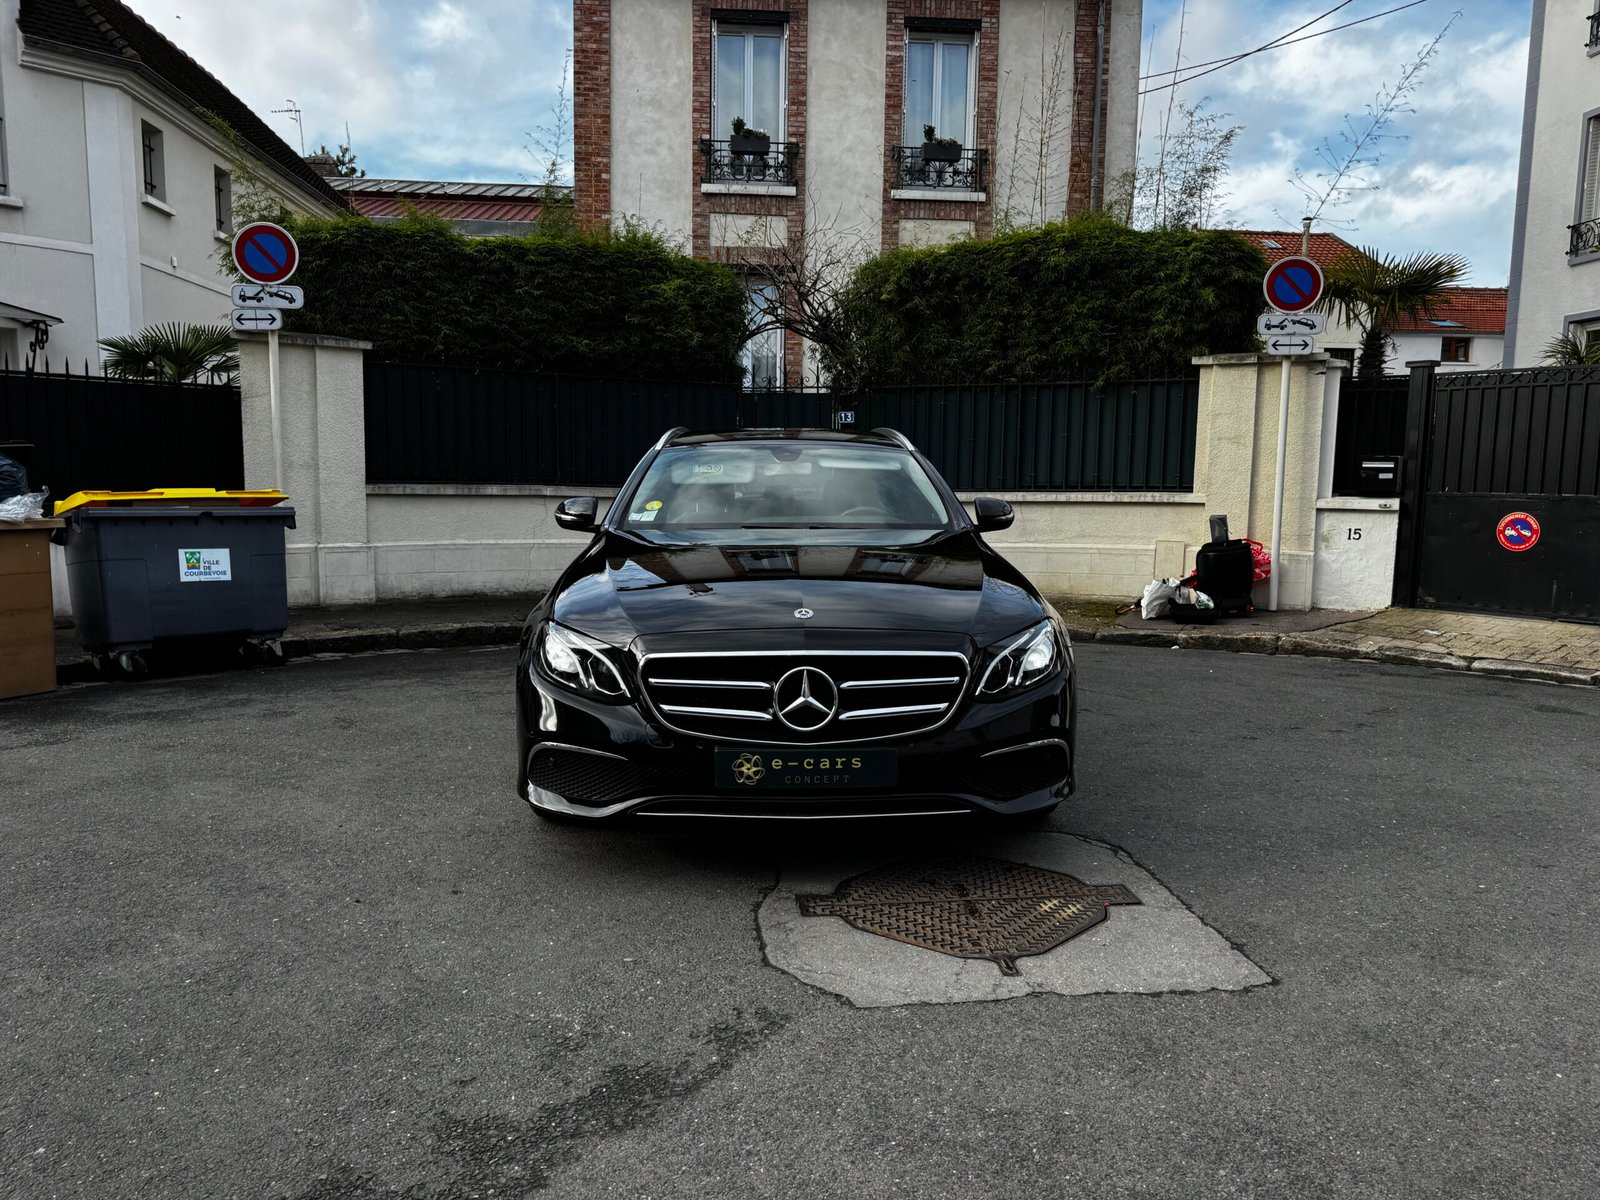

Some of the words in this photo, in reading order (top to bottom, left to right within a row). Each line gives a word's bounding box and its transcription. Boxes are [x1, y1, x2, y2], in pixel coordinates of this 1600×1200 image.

[841, 413, 852, 422] 13
[1347, 528, 1362, 540] 15
[772, 757, 862, 769] e-cars
[784, 775, 850, 784] CONCEPT
